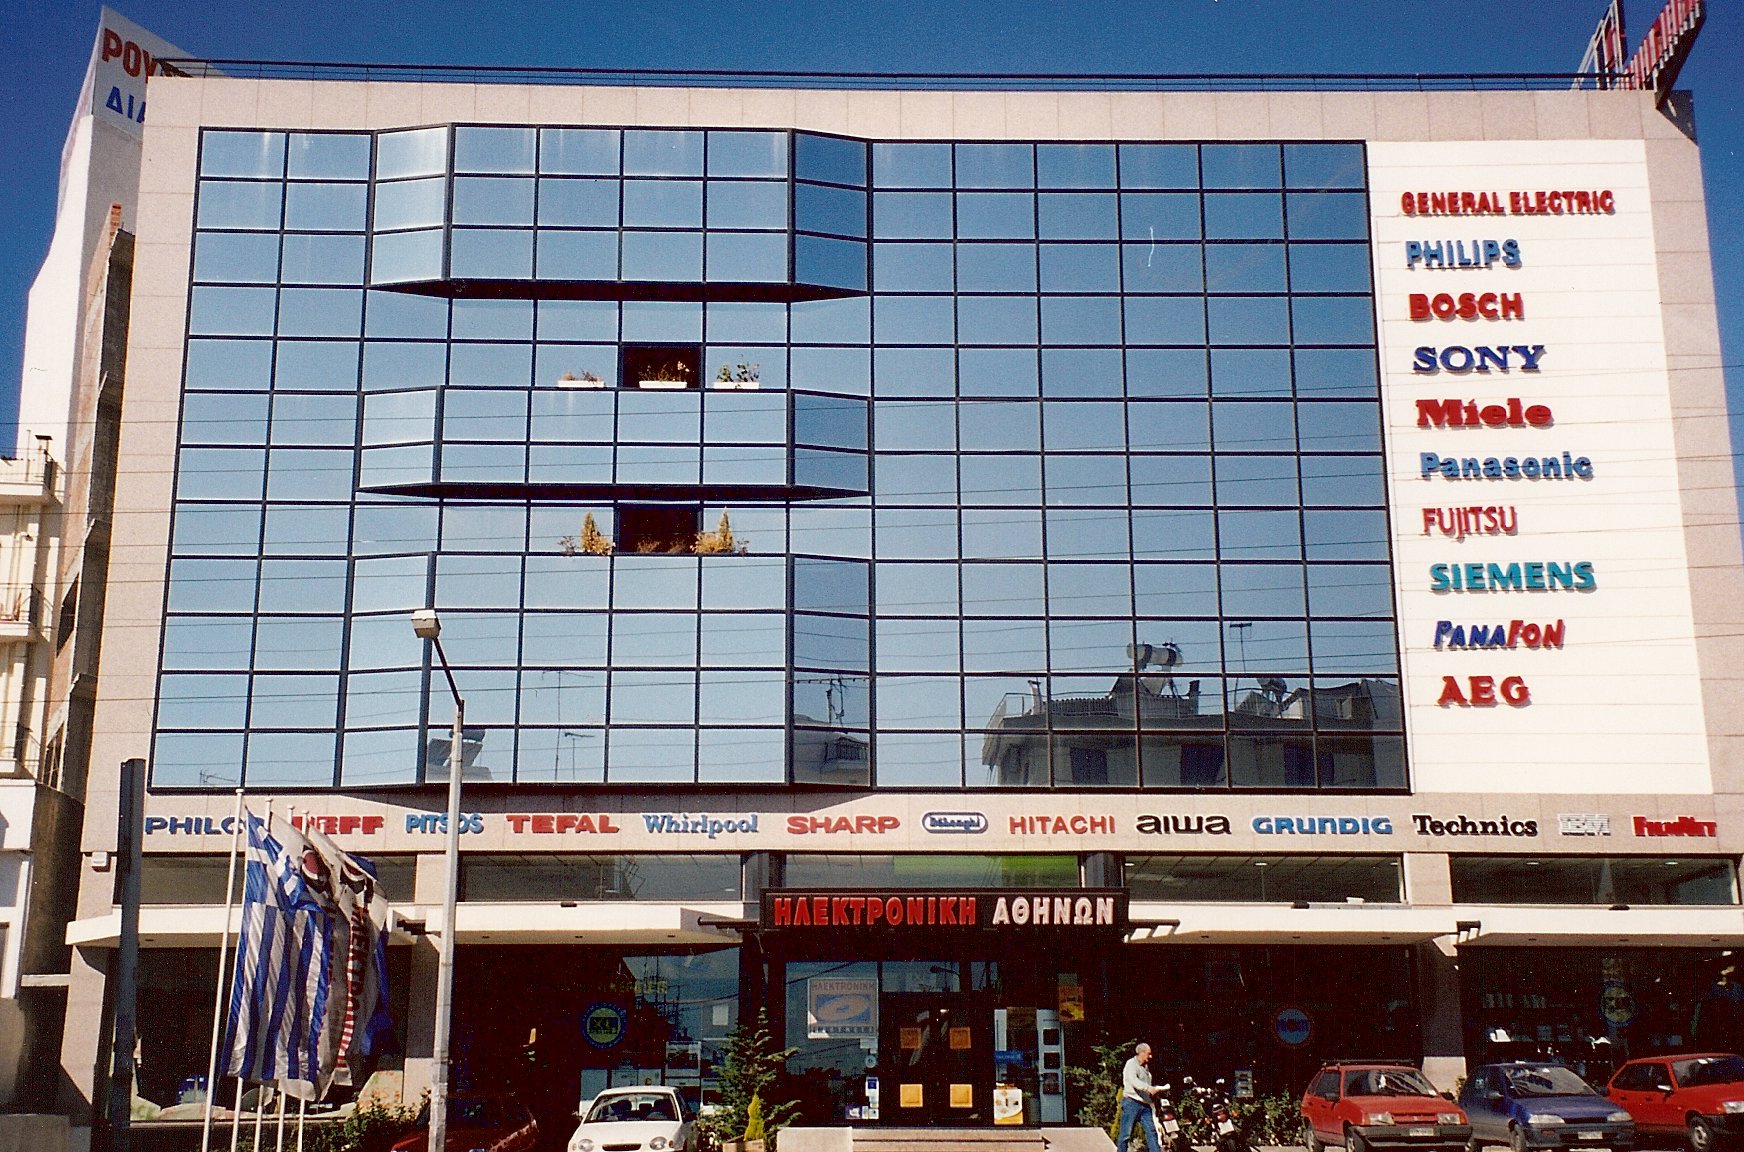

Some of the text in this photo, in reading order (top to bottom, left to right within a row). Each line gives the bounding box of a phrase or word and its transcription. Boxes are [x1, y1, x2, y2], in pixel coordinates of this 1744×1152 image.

[1401, 190, 1615, 214] GENERAL ELECTRIC
[1406, 239, 1521, 267] PHILIPS
[1408, 292, 1523, 320] BOSCH
[1413, 345, 1544, 372] SONY
[1416, 398, 1552, 427] Miele
[1420, 451, 1593, 478] Panasonic
[1422, 506, 1517, 541] FUJITSU
[1430, 561, 1596, 591] SIEMENS
[1437, 676, 1530, 705] AEG
[506, 815, 620, 834] TEFAL
[643, 814, 759, 838] Whirlpool
[787, 816, 900, 834] SHARP
[1010, 816, 1115, 834] HITACHI
[1136, 814, 1231, 834] aiwa
[1252, 817, 1393, 834] GRUNDIG
[1412, 815, 1538, 836] Technics
[774, 896, 1115, 926] ΗΛΕΚΤΡΟΝΙΚΗ ΑΘΗΝΩΝ
